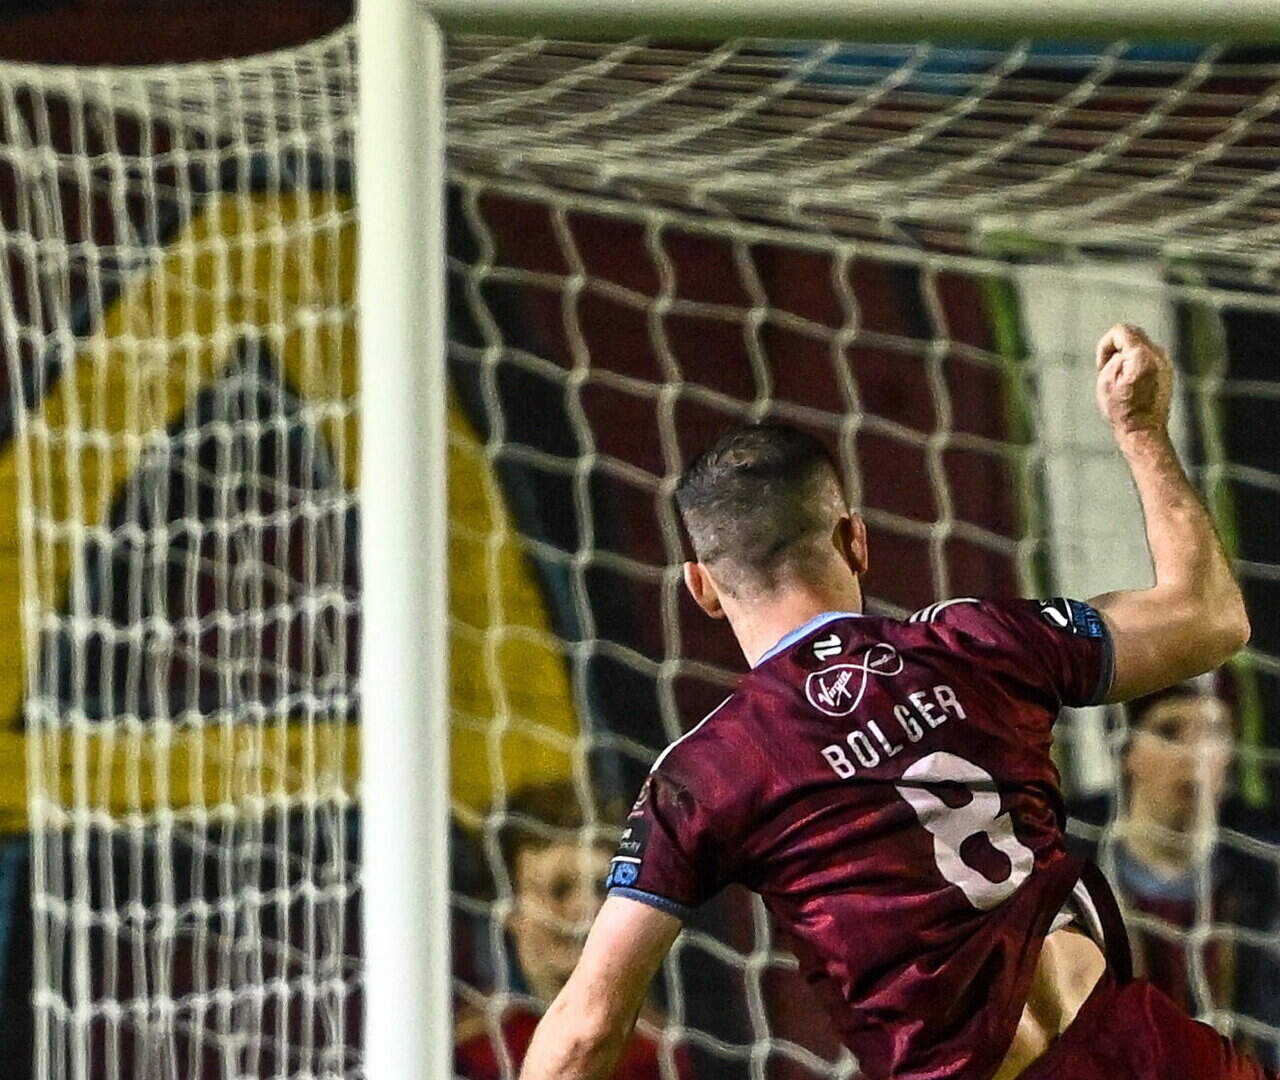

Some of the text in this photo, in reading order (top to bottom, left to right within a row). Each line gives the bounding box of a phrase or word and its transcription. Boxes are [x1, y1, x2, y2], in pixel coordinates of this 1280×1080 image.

[817, 670, 853, 706] Virgin
[821, 685, 966, 780] BOLGER
[895, 751, 1034, 910] 8
